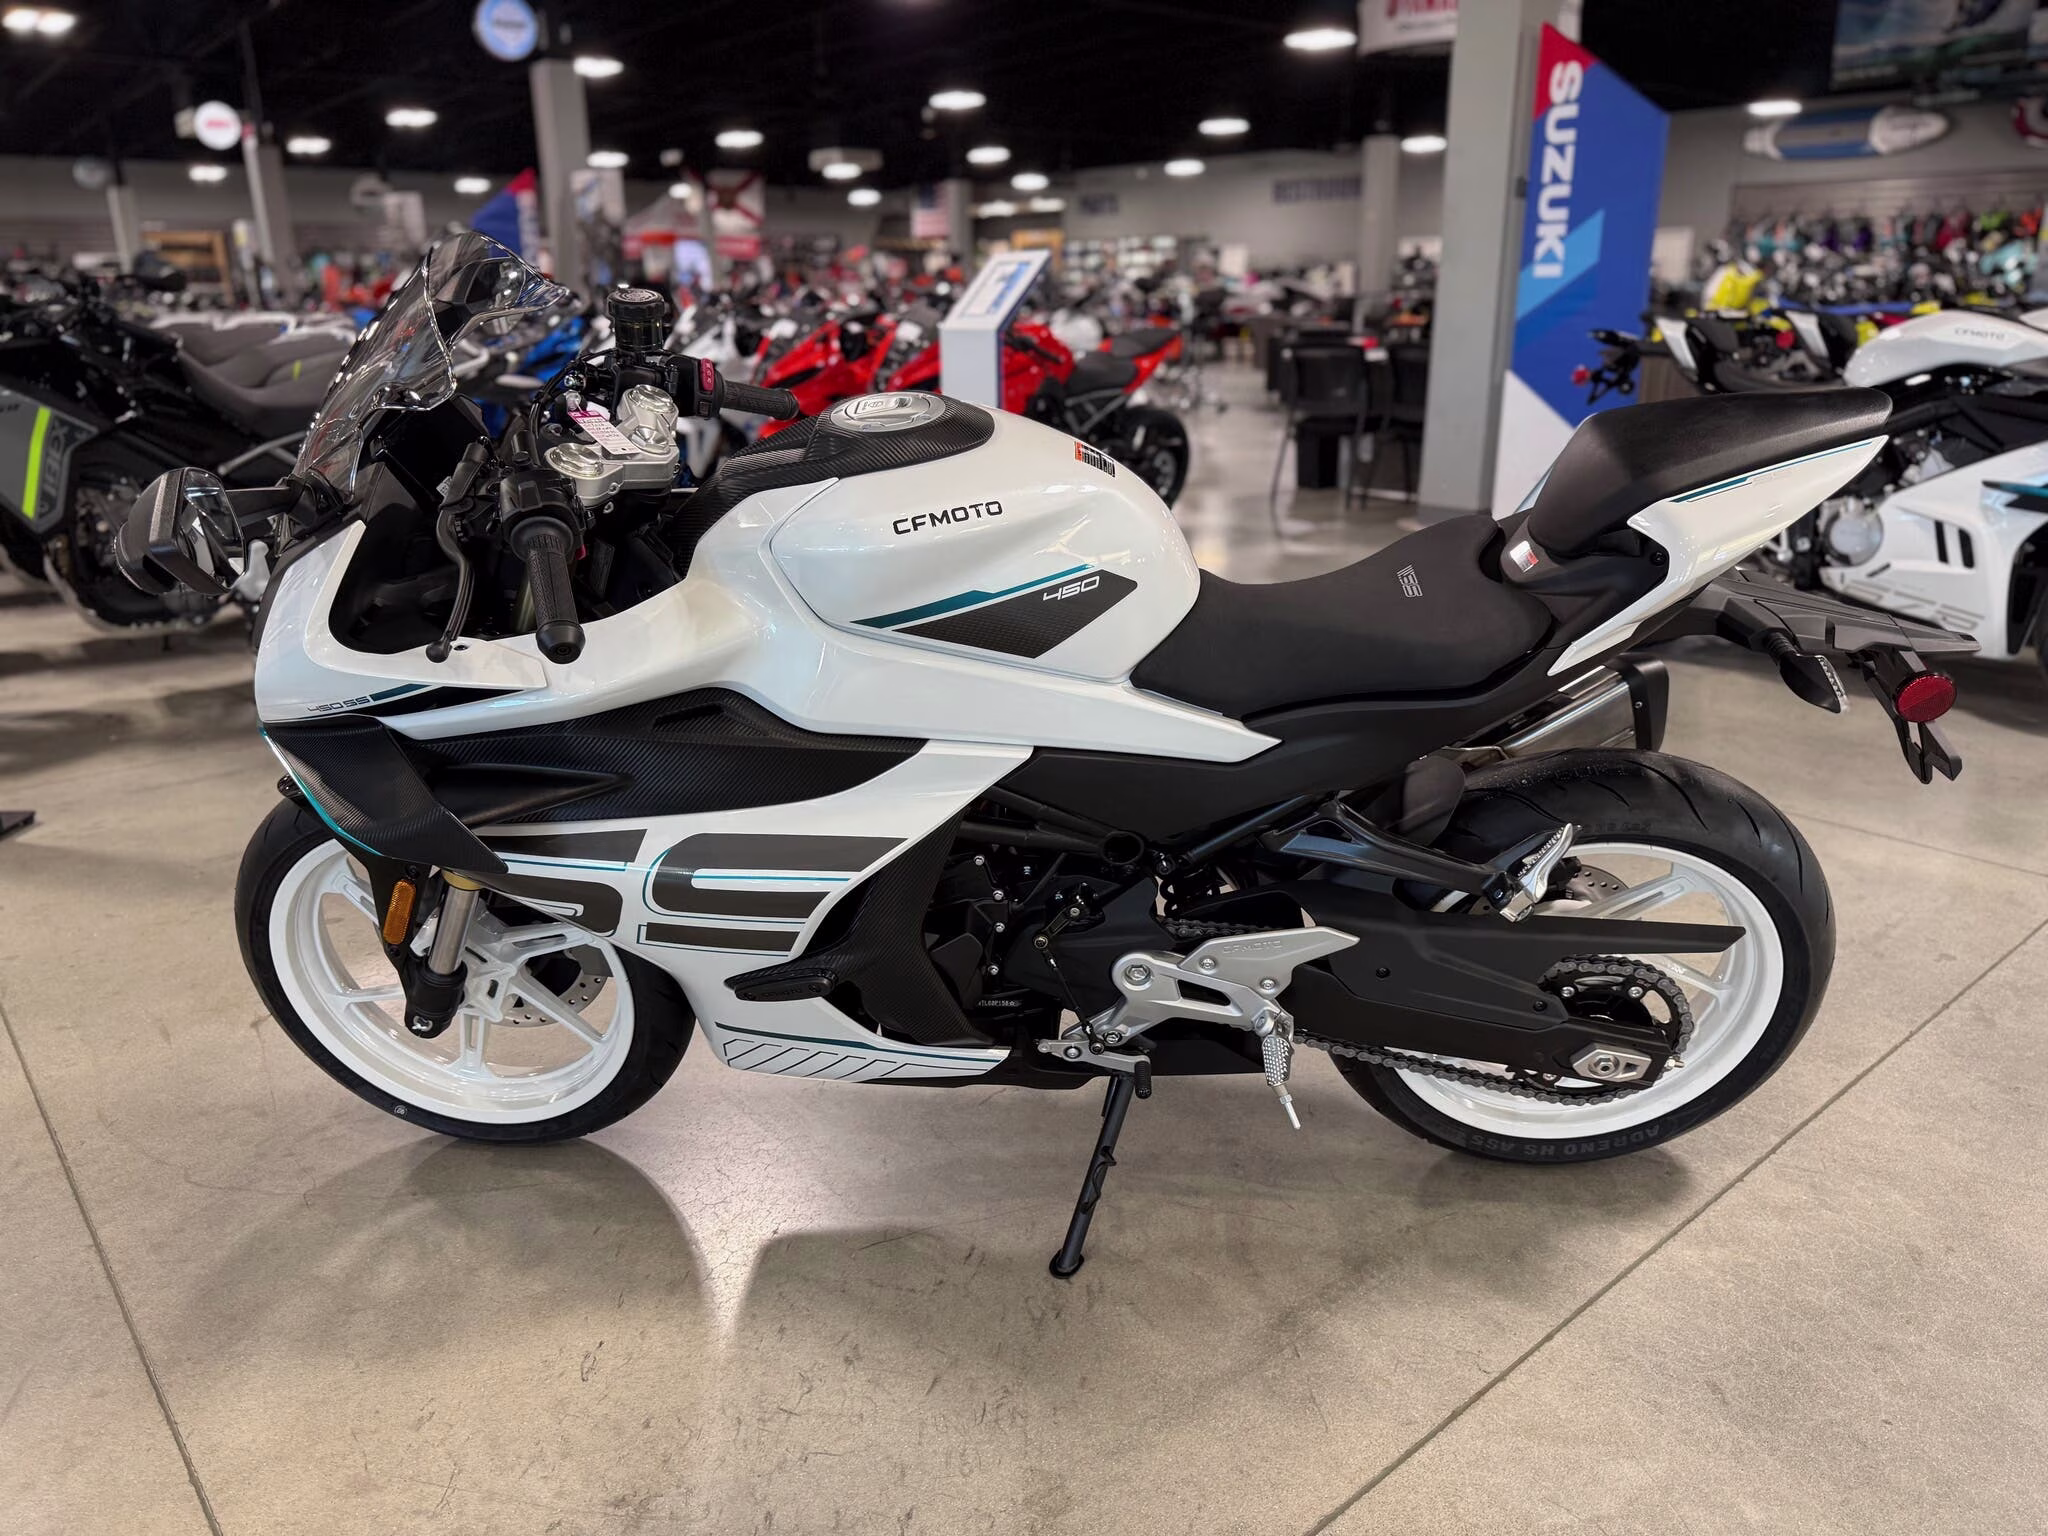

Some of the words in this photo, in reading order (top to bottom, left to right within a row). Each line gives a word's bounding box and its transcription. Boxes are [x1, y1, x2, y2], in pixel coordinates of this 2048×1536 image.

[1532, 60, 1584, 278] SUZUKI
[893, 500, 1003, 535] CFMOTO
[1043, 575, 1099, 601] 450
